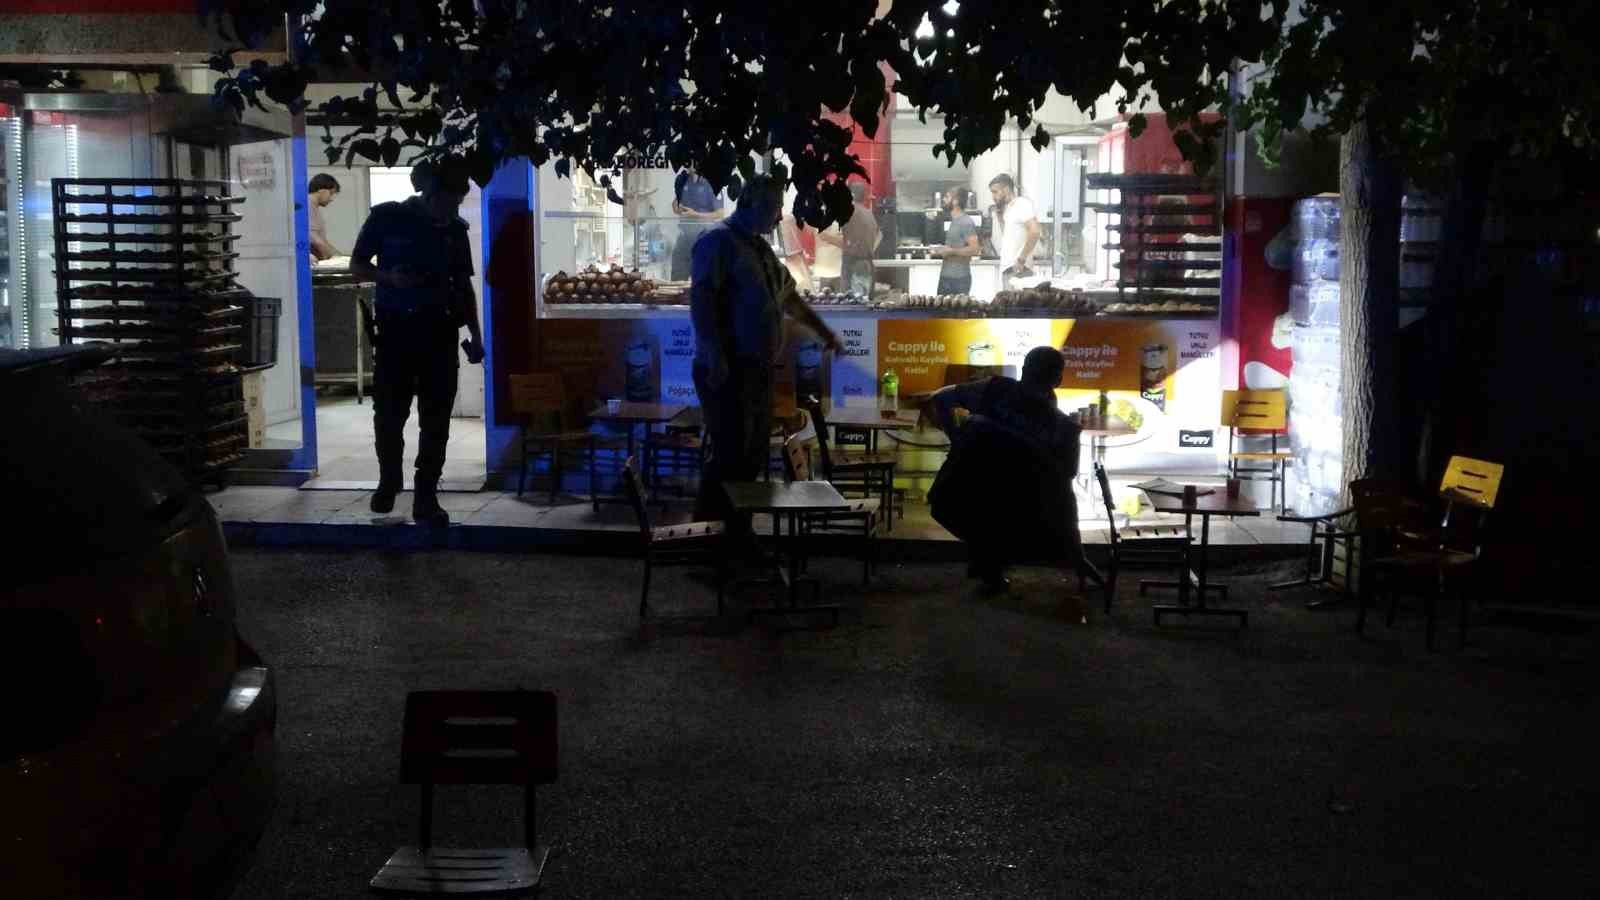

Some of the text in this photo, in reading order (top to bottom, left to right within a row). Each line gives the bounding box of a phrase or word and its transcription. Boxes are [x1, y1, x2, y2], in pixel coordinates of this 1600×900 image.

[888, 341, 928, 354] Cappy
[1060, 345, 1100, 358] Cappy
[1181, 433, 1210, 446] Cappy
